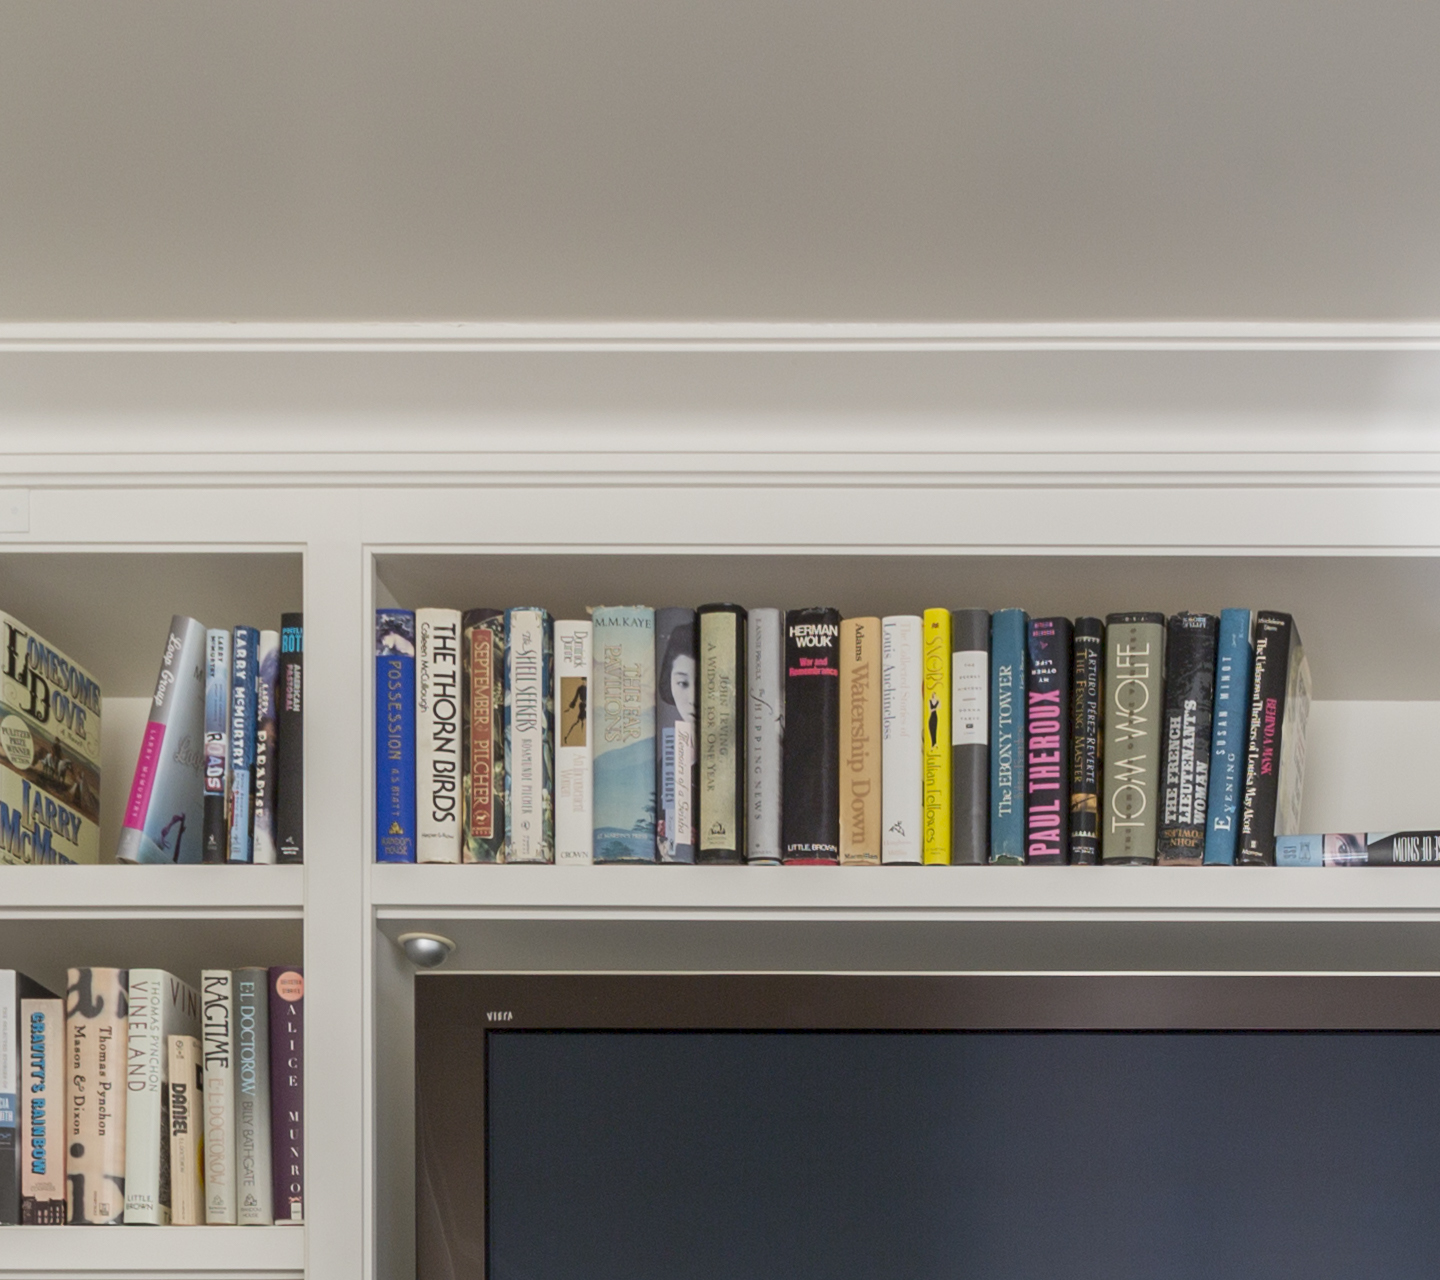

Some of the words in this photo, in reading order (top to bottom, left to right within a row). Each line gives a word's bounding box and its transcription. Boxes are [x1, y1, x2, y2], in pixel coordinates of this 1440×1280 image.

[164, 633, 182, 666] Loop
[236, 630, 247, 679] LARRY
[420, 623, 429, 657] Colleen
[433, 624, 455, 663] THE
[789, 626, 837, 637] HERMAN
[796, 636, 832, 647] WOUK
[855, 623, 865, 662] Adams
[154, 670, 174, 706] Group
[388, 661, 403, 759] POSSESSION
[419, 660, 429, 713] McCullough
[433, 671, 455, 754] THORN
[474, 642, 489, 726] SEPTEMBER
[1000, 665, 1012, 727] TOWER
[1115, 643, 1149, 742] WOLFE
[233, 687, 246, 766] McMURTRY
[848, 663, 869, 773] Watership
[1029, 690, 1060, 793] THEROUX
[474, 740, 490, 807] PILCHER
[999, 731, 1012, 786] EBONY
[433, 760, 455, 822] BIRDS
[851, 779, 871, 845] Down
[999, 790, 1012, 817] The
[1112, 755, 1147, 833] TOM
[1029, 800, 1060, 856] PAUL
[31, 1012, 45, 1092] GRAVITY'S
[73, 1025, 85, 1068] Mason
[98, 1026, 112, 1076] Thomas
[129, 982, 148, 1092] VINELAND
[205, 977, 229, 1068] RAGTIME
[240, 1006, 255, 1095] DOCTOROW
[31, 1099, 46, 1175] RAINBOW
[73, 1095, 85, 1135] Dixon
[97, 1082, 111, 1136] Pynchon
